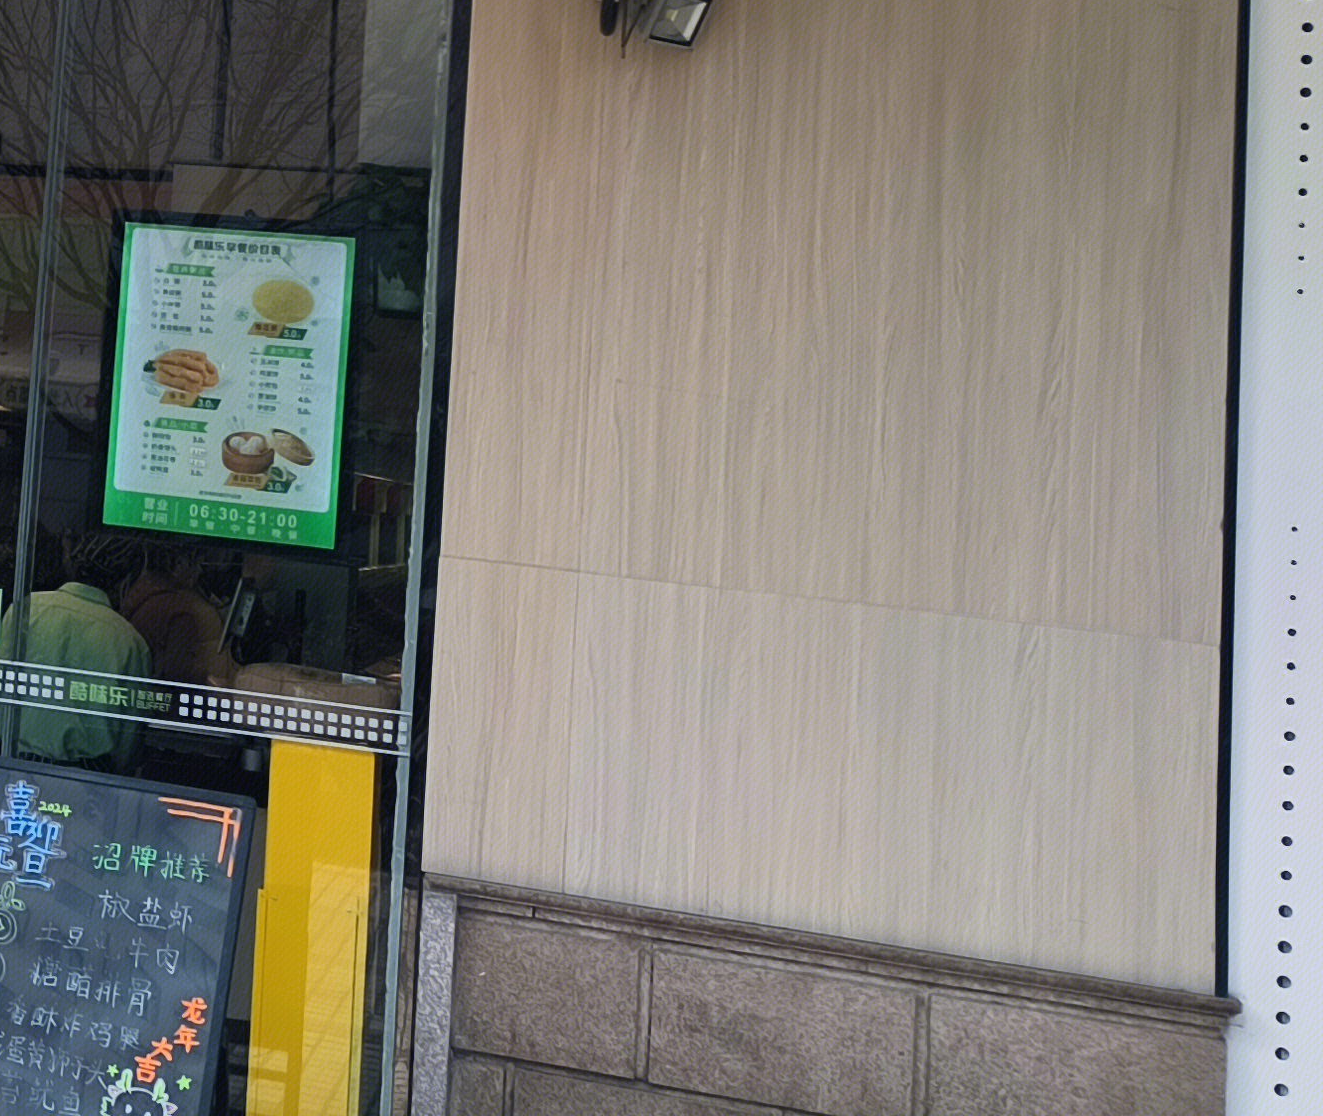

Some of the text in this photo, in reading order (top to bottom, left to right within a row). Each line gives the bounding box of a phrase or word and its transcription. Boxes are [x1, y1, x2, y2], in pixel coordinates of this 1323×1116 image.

[189, 503, 298, 529] 06:30-21:00
[69, 680, 129, 707] 酷味乐
[37, 800, 73, 818] 2024
[29, 955, 152, 1017] 糖醋排骨
[134, 996, 209, 1084] 龙年大吉
